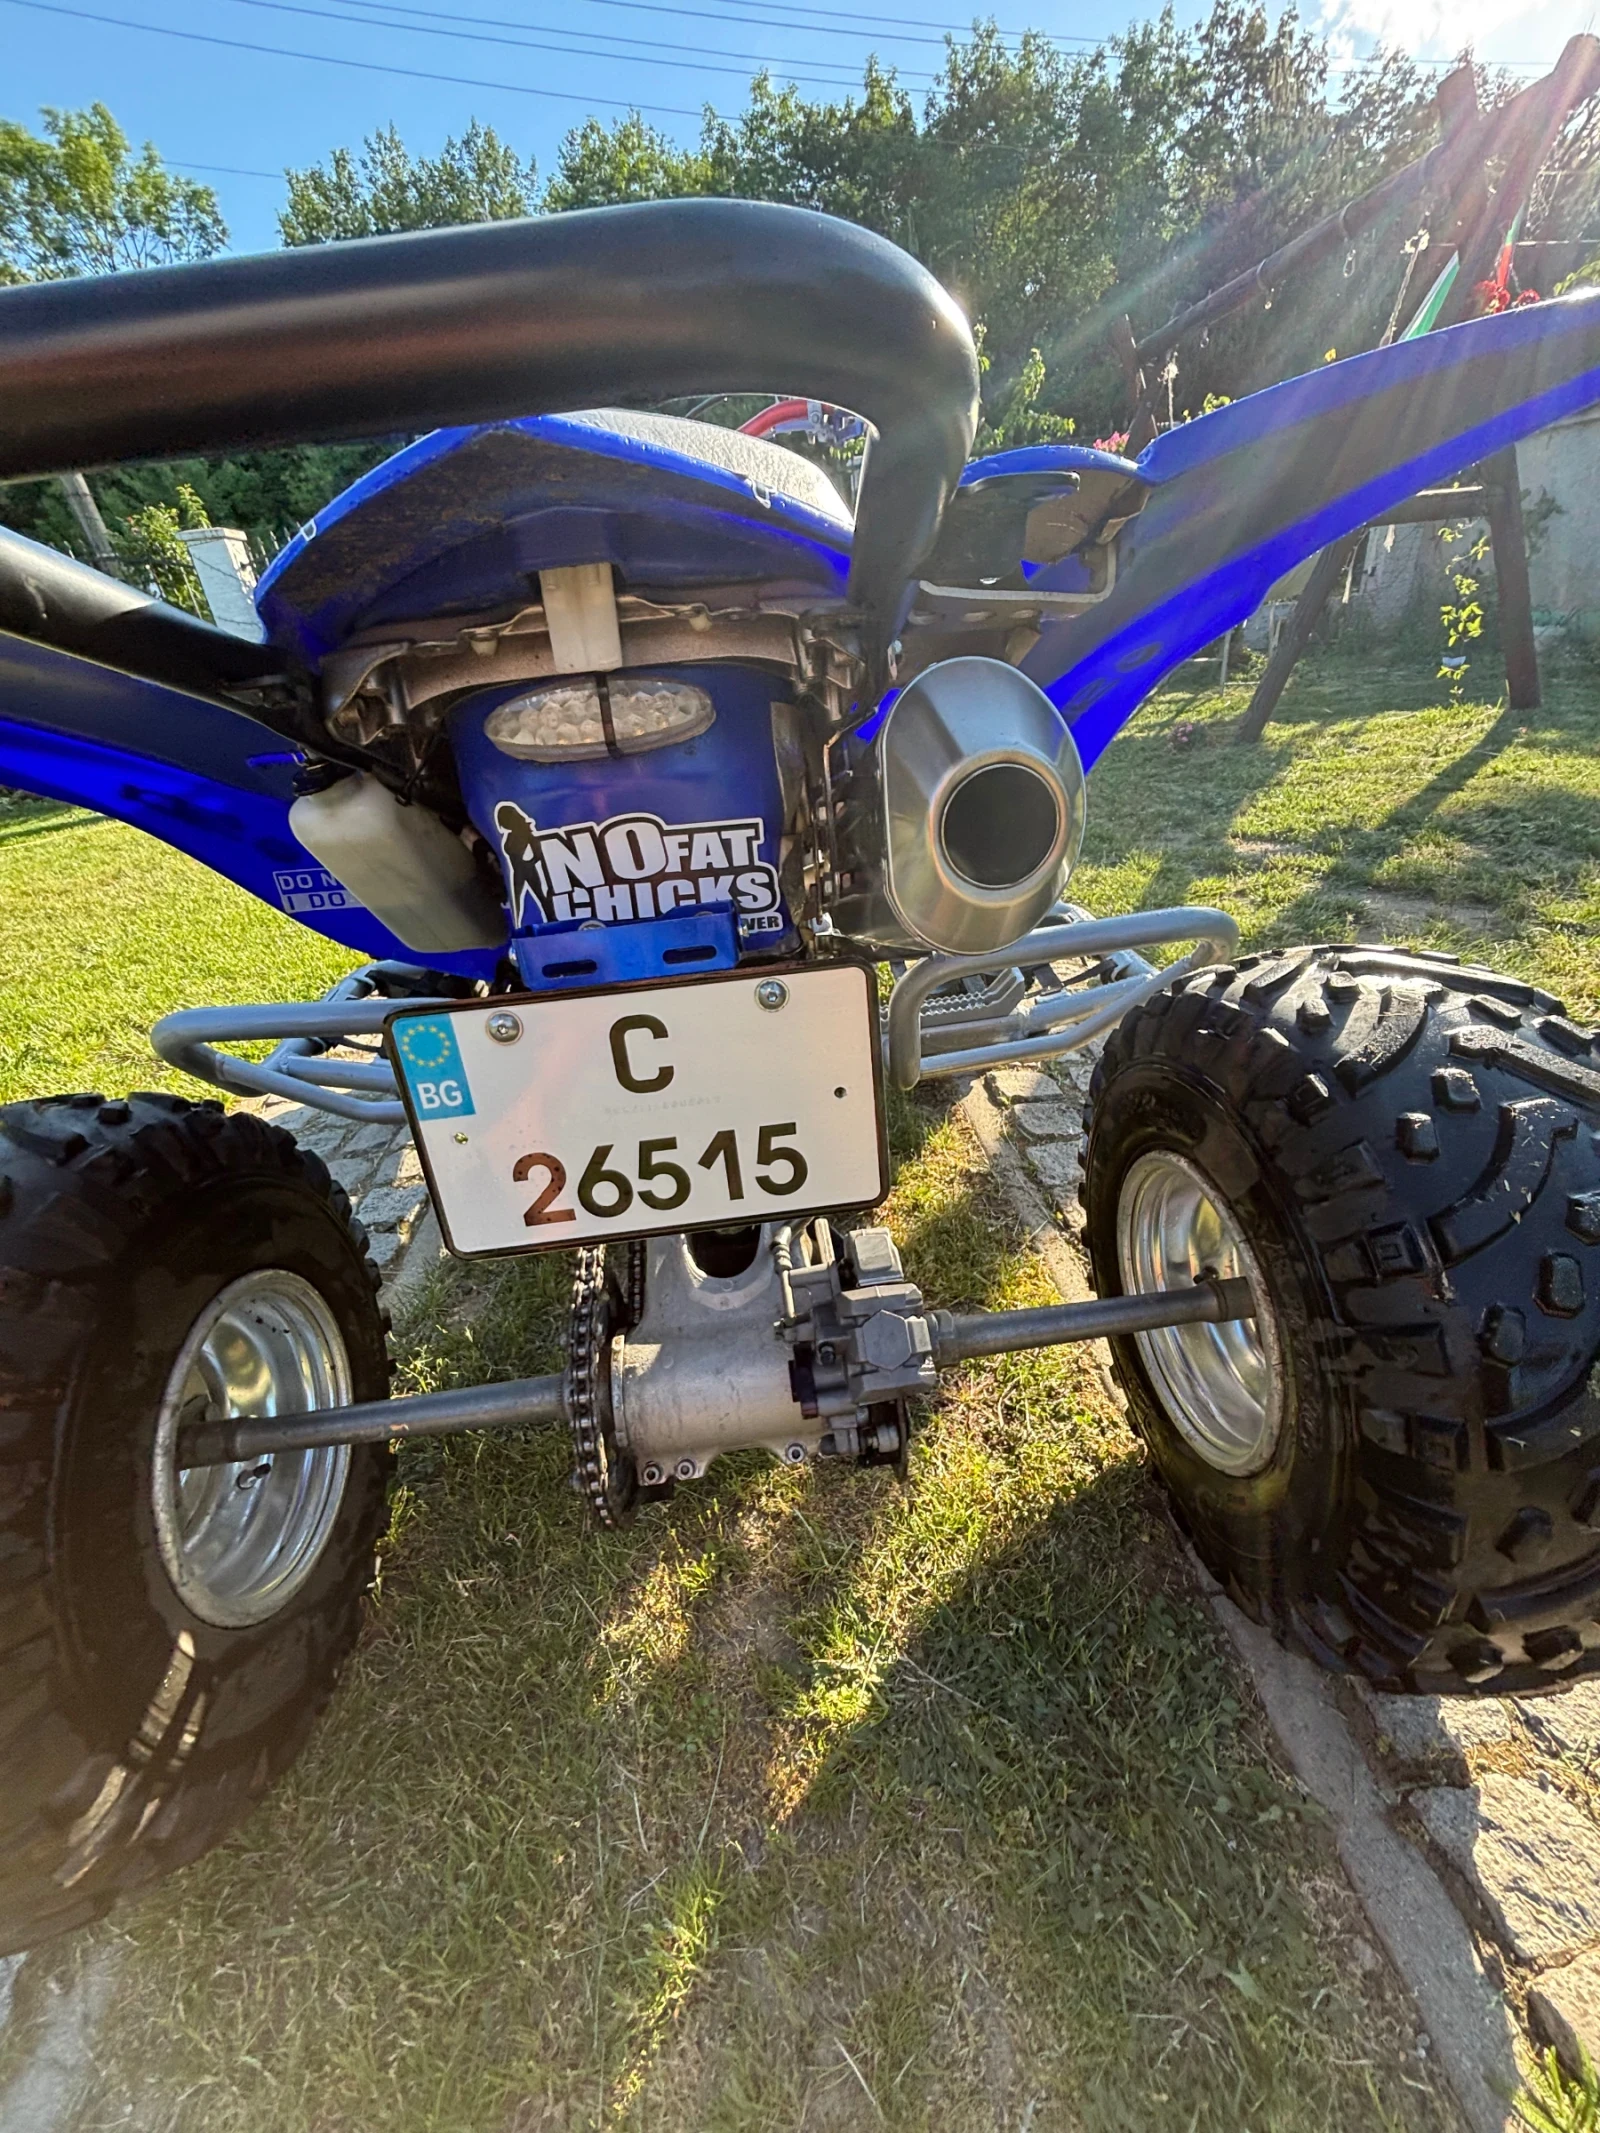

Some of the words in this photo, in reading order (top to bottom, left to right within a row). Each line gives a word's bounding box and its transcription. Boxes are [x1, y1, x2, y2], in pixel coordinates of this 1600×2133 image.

[278, 874, 313, 890] DO
[320, 872, 338, 887] N
[540, 821, 667, 894] NO
[663, 829, 756, 873] FAT
[287, 895, 295, 910] I
[308, 892, 345, 909] DO
[552, 872, 776, 921] CHICKS
[609, 1013, 675, 1094] C
[416, 1079, 463, 1110] BG
[512, 1121, 808, 1227] 26515
